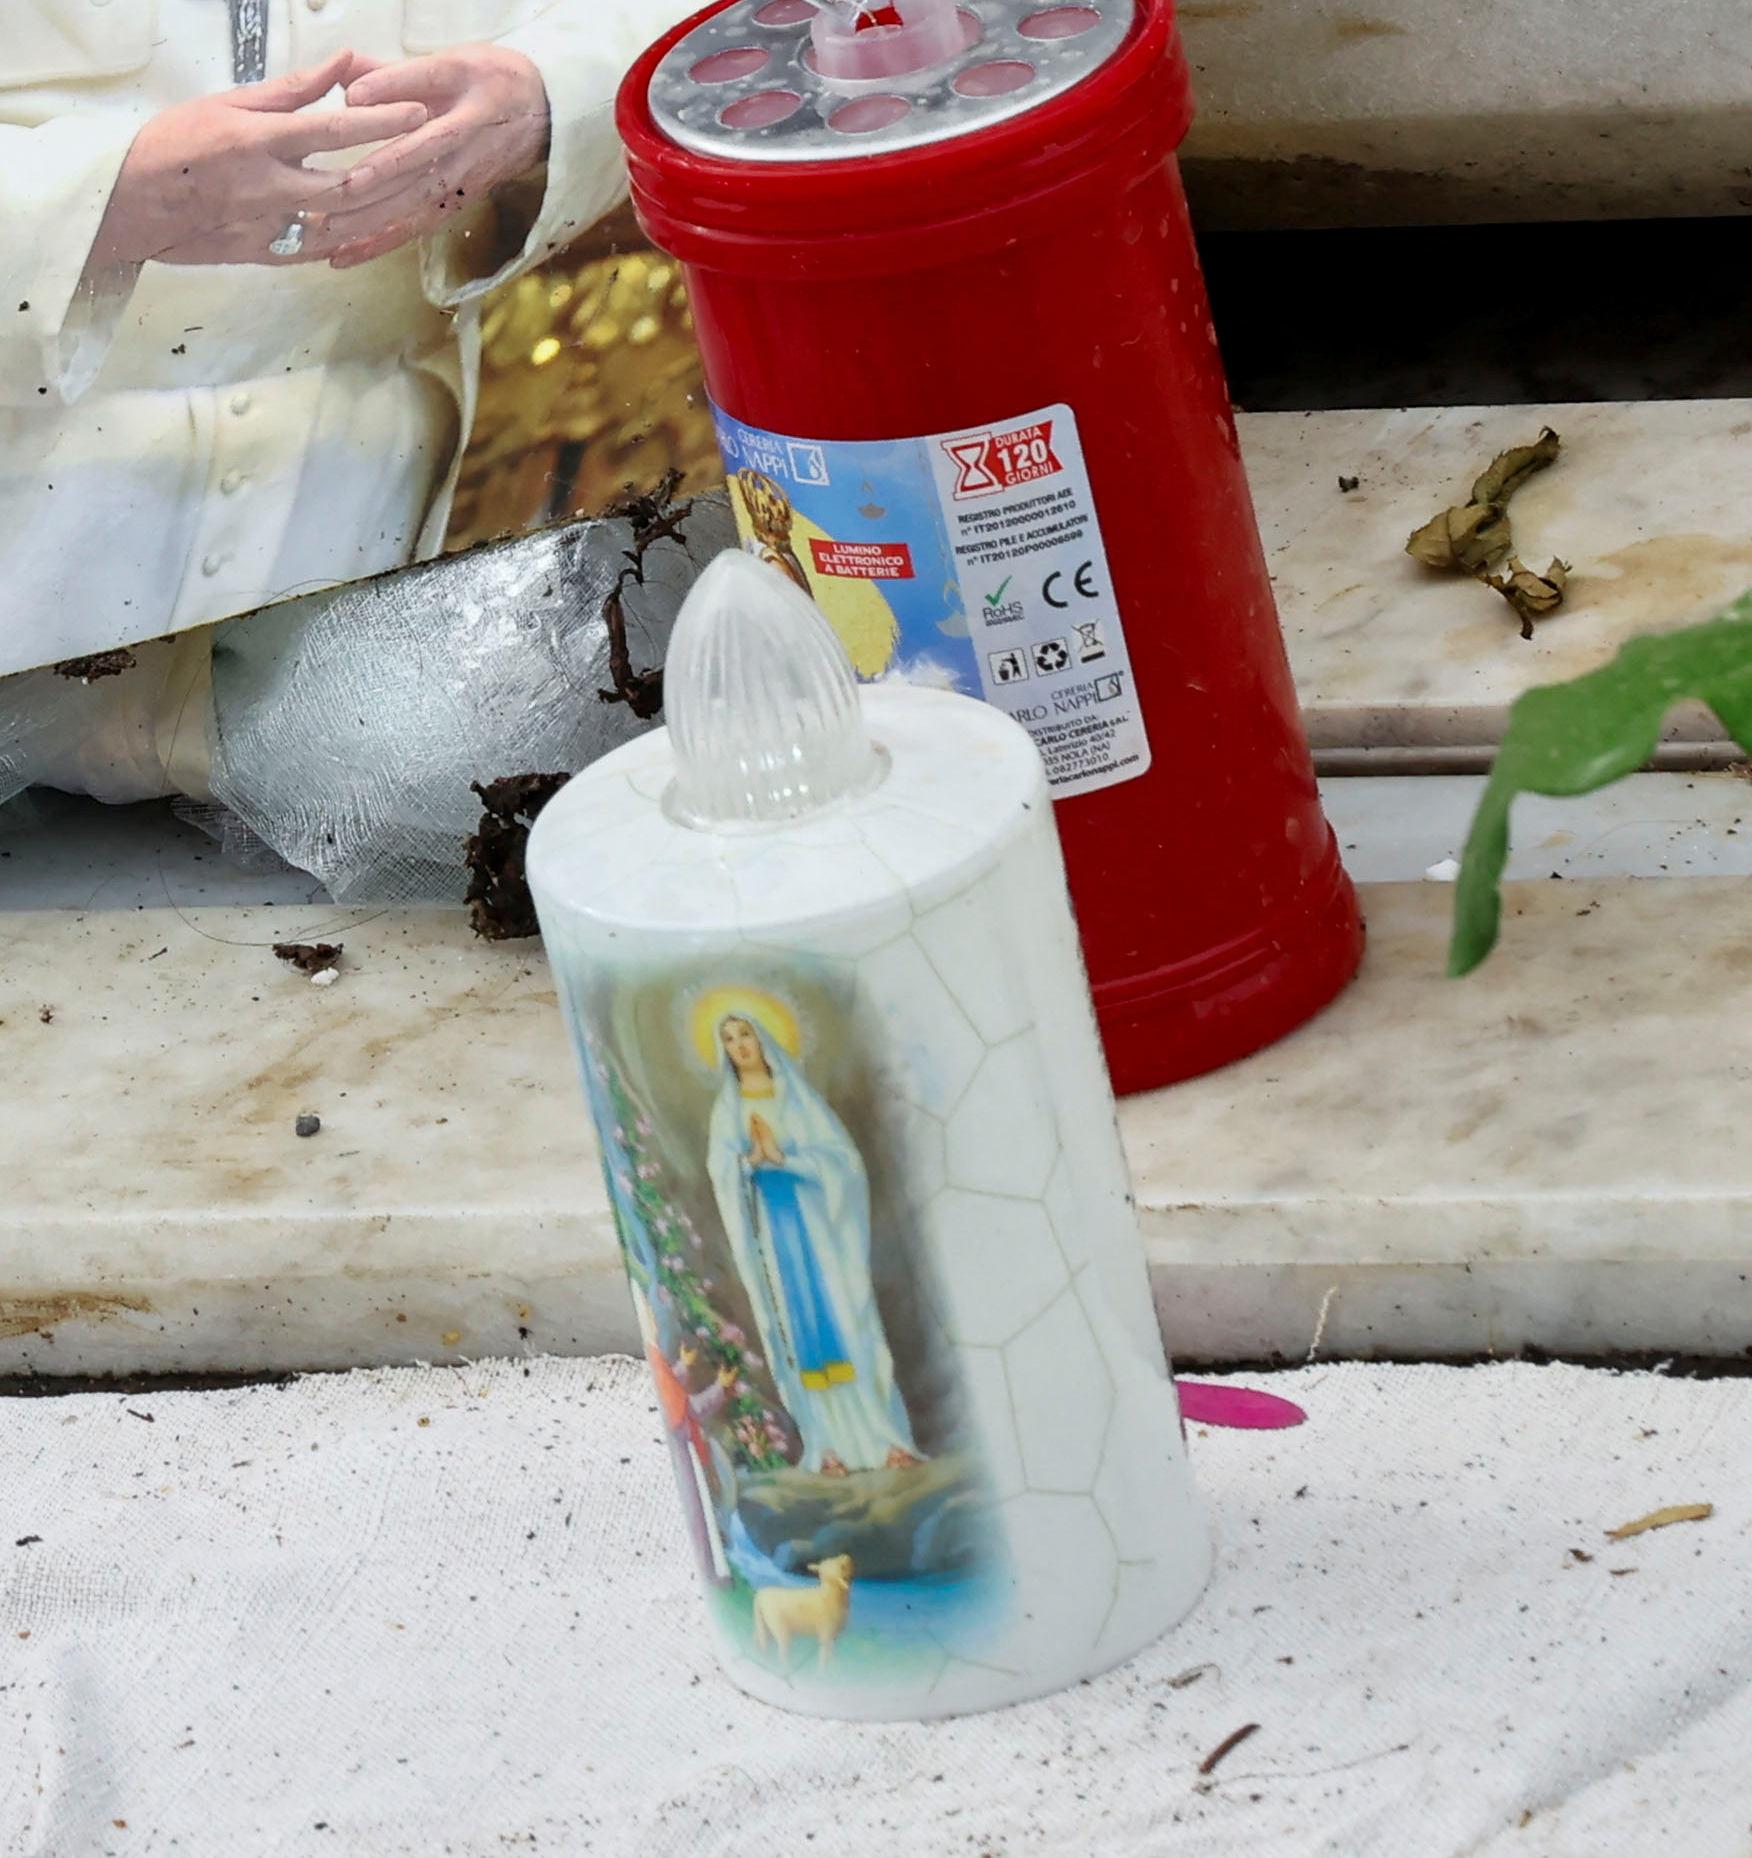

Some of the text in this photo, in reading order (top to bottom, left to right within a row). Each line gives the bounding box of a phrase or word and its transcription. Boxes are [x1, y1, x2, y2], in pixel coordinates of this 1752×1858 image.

[996, 426, 1043, 448] DURATA
[997, 439, 1048, 473] 120
[1005, 462, 1054, 485] GIORNI
[819, 552, 904, 567] ELETTRONICO
[833, 544, 882, 556] LUMINO
[824, 565, 900, 578] A BATTERIE
[982, 601, 1024, 621] RoHS
